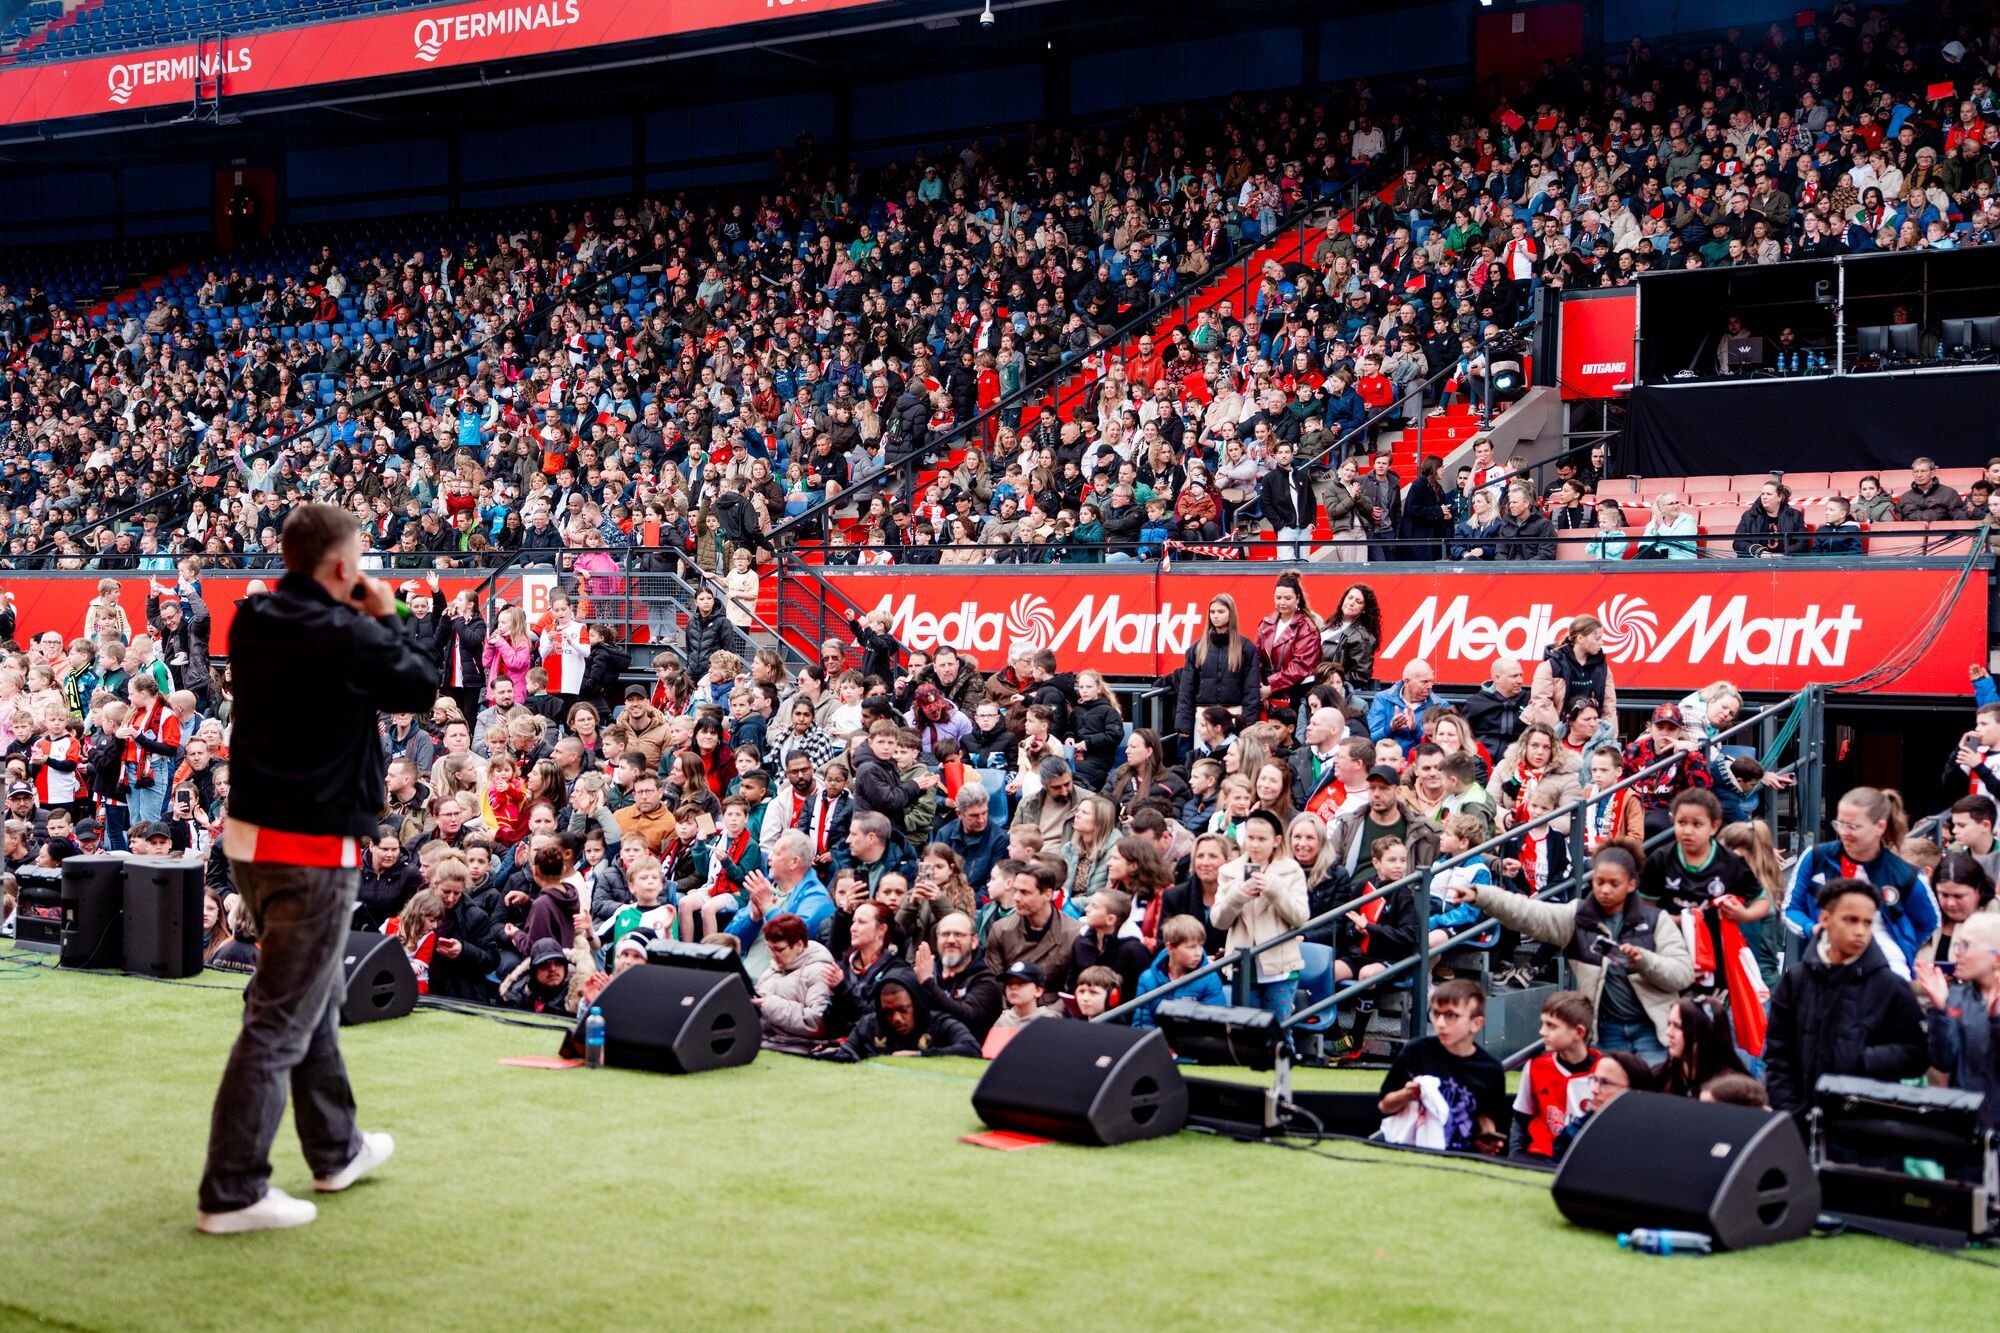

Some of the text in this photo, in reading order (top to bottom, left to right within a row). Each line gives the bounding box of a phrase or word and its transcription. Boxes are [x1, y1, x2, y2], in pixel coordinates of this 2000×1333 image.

[414, 0, 580, 62] QTERMINALS
[108, 48, 252, 104] QTERMINALS
[1582, 362, 1626, 375] UITGANG
[1447, 427, 1456, 438] 8
[531, 584, 548, 614] B
[851, 593, 1202, 655] Media Markt
[1645, 595, 1862, 666] Markt
